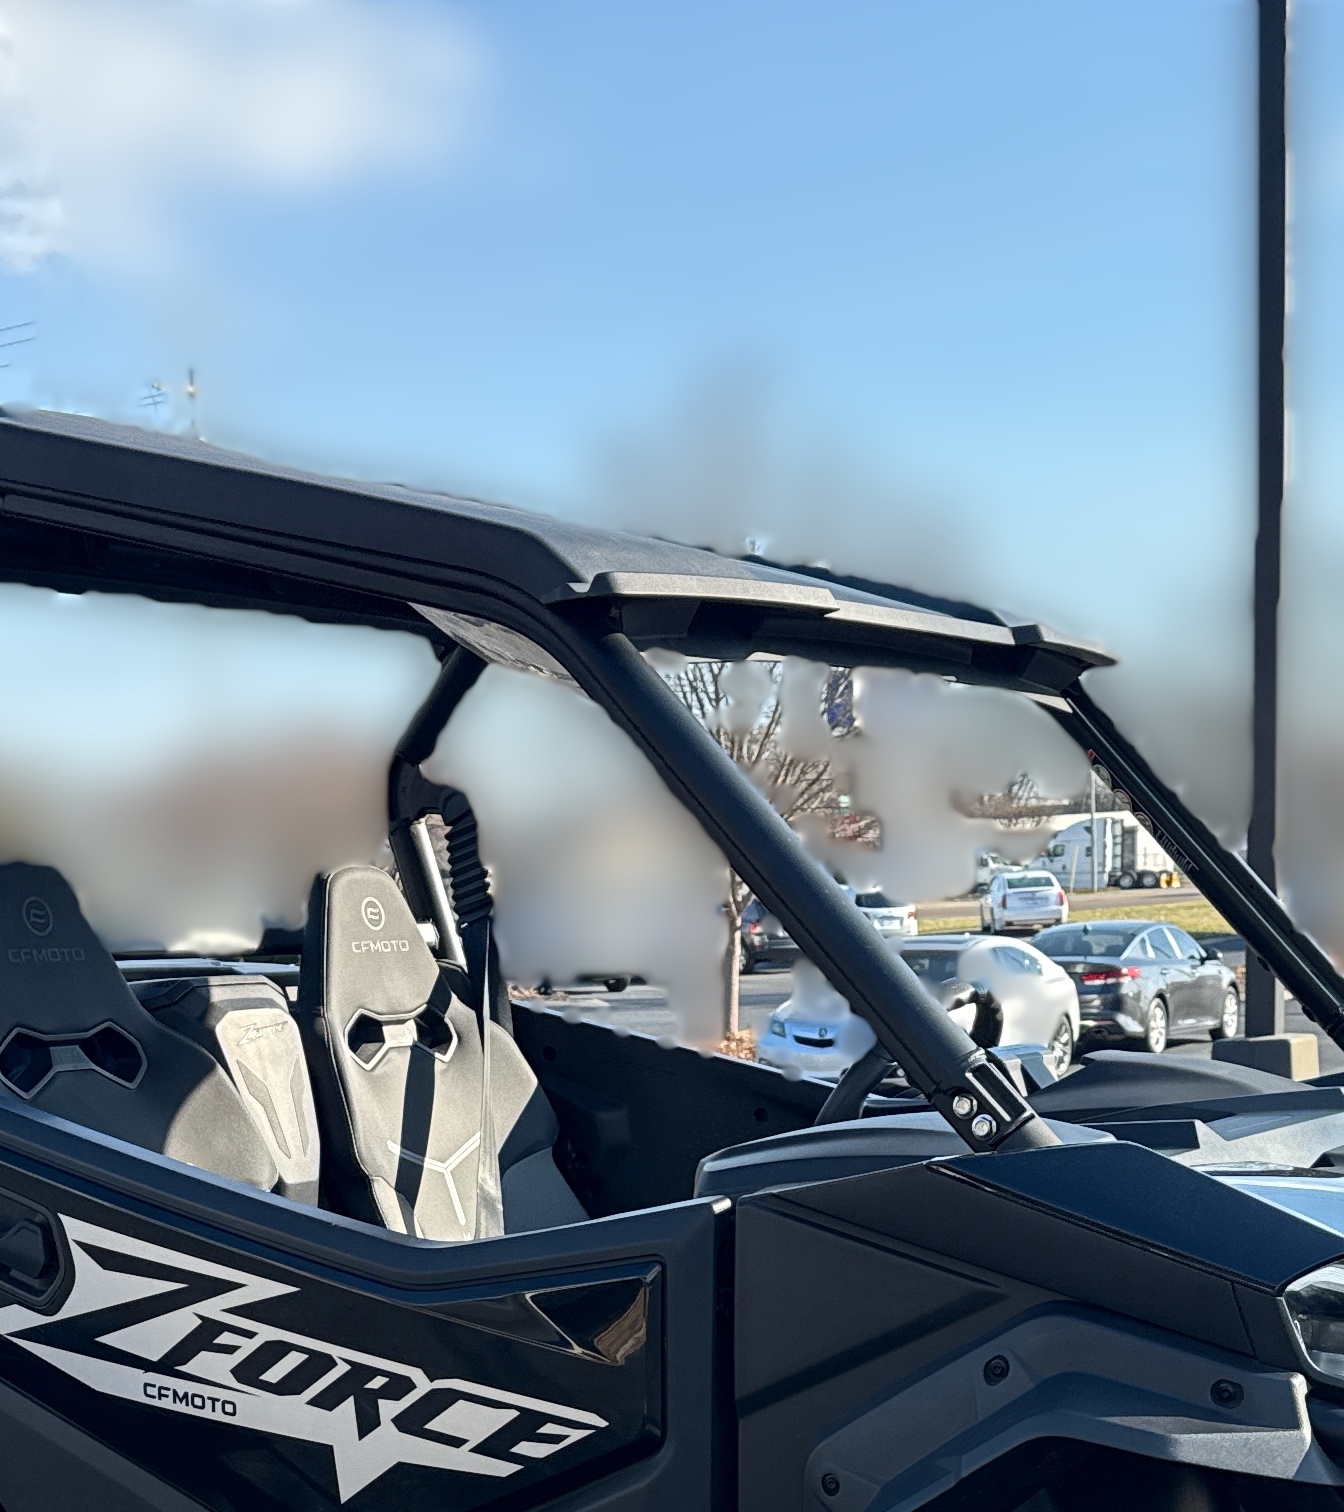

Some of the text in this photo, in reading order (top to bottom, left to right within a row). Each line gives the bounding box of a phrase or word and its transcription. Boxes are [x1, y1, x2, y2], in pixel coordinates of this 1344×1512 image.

[351, 940, 410, 953] CFMOTO
[8, 947, 86, 963] CFMOTO
[142, 1382, 237, 1417] CFMOTO
